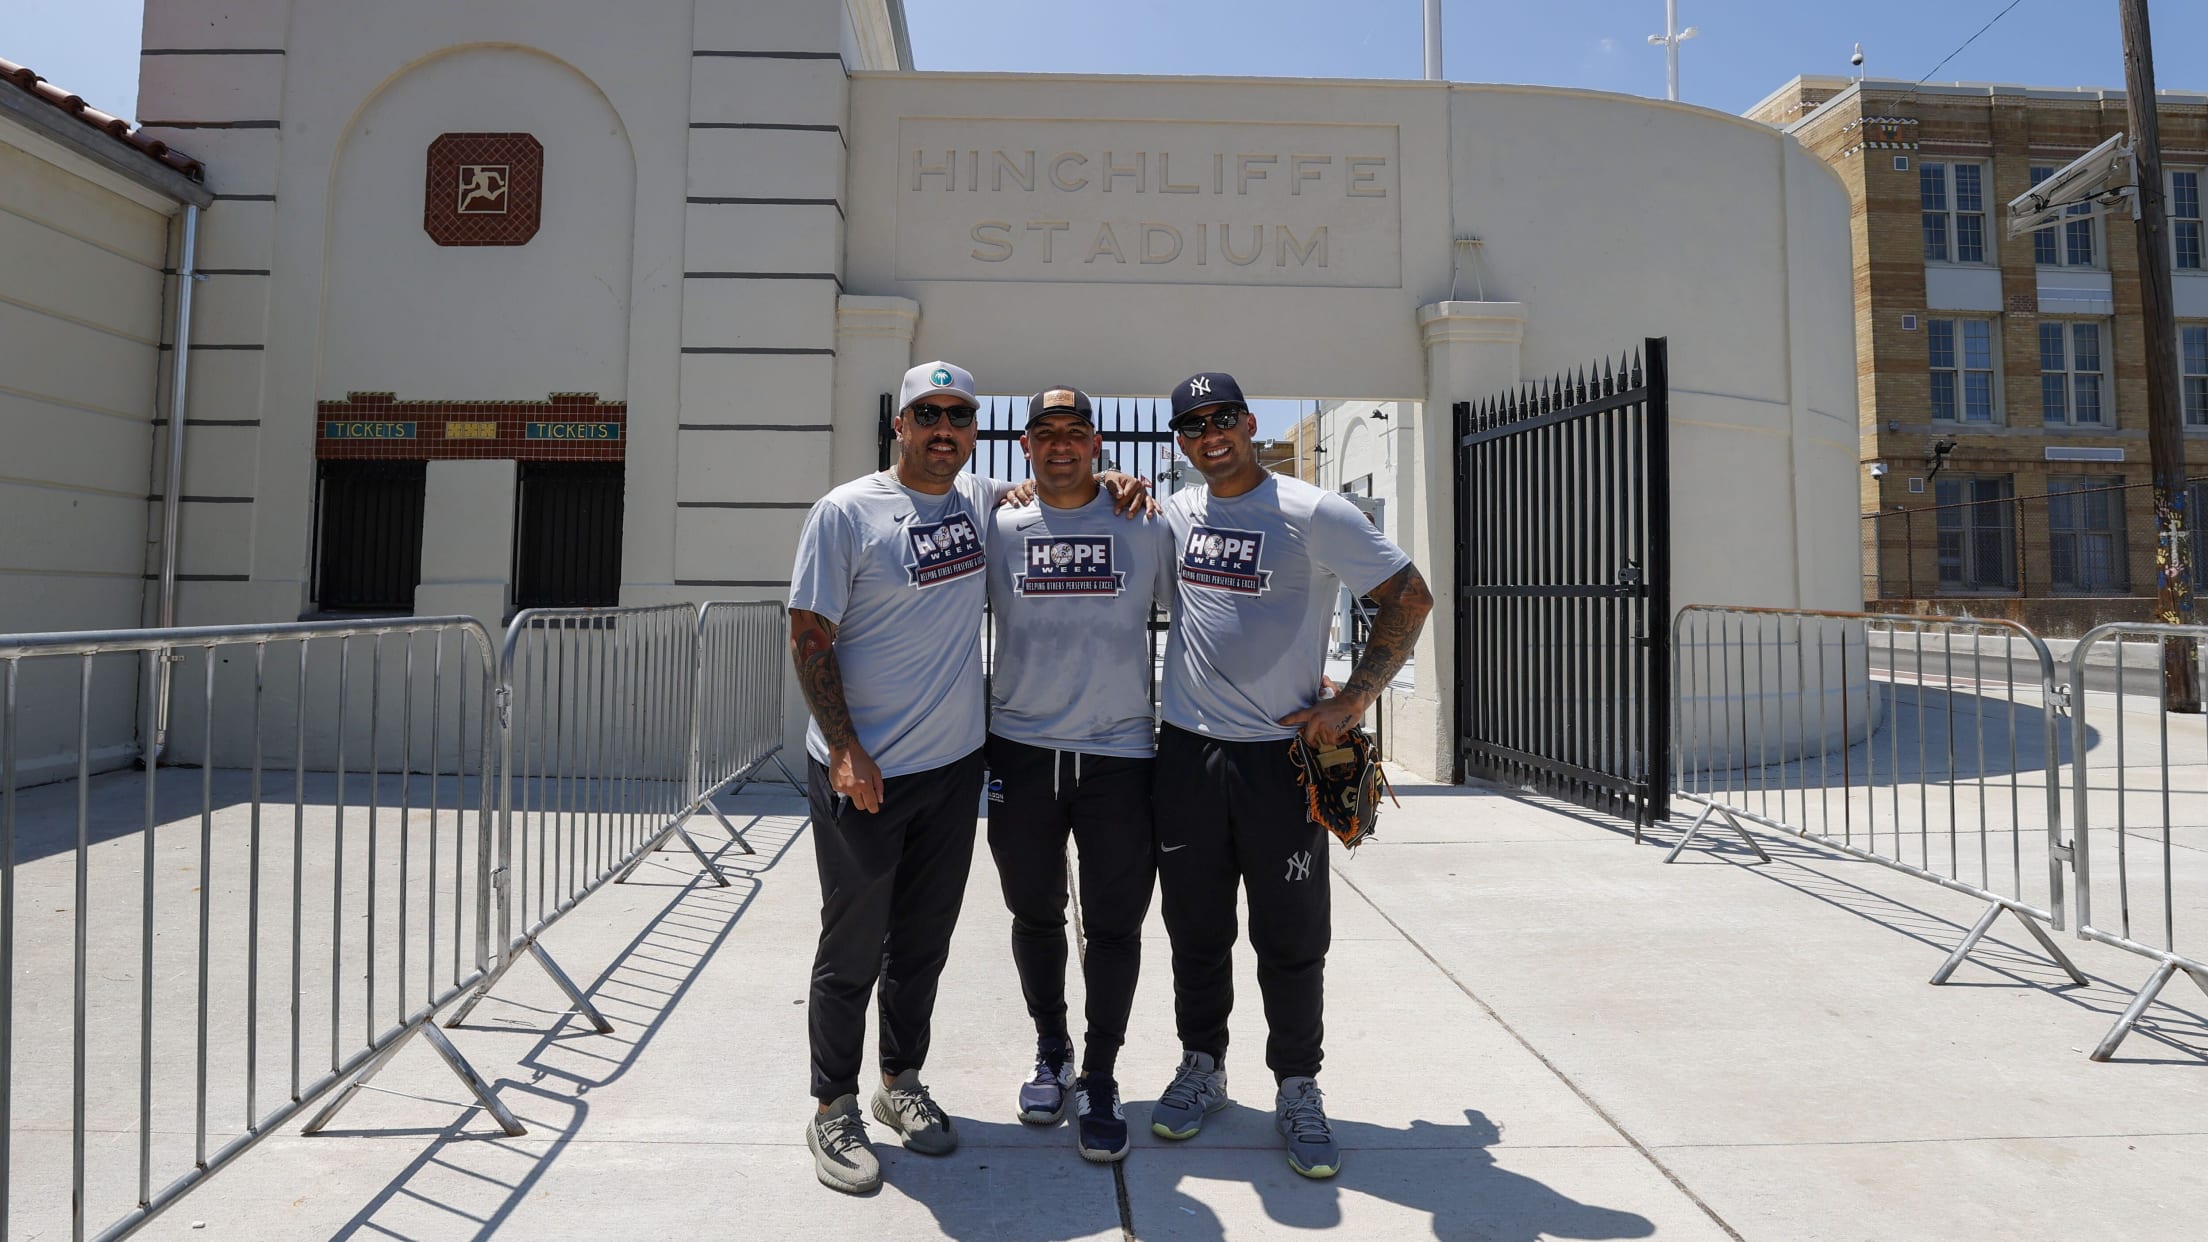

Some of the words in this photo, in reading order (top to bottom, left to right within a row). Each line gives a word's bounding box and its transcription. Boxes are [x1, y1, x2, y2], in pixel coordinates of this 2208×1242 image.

[911, 149, 1387, 198] HINCHLIFFE
[969, 221, 1330, 268] STADIUM
[1190, 375, 1211, 396] NY
[335, 423, 405, 437] TICKETS
[536, 423, 608, 438] TICKETS
[913, 520, 976, 555] HOPE
[1188, 533, 1256, 561] HOPE
[930, 543, 973, 560] WEEK
[1031, 542, 1106, 566] HOPE
[1194, 556, 1242, 569] WEEK
[1025, 582, 1045, 591] HELPING
[1046, 581, 1064, 590] OTHERS
[1065, 581, 1092, 590] PERSEVERE
[1099, 580, 1113, 590] EXCEL
[1284, 850, 1312, 882] NY
